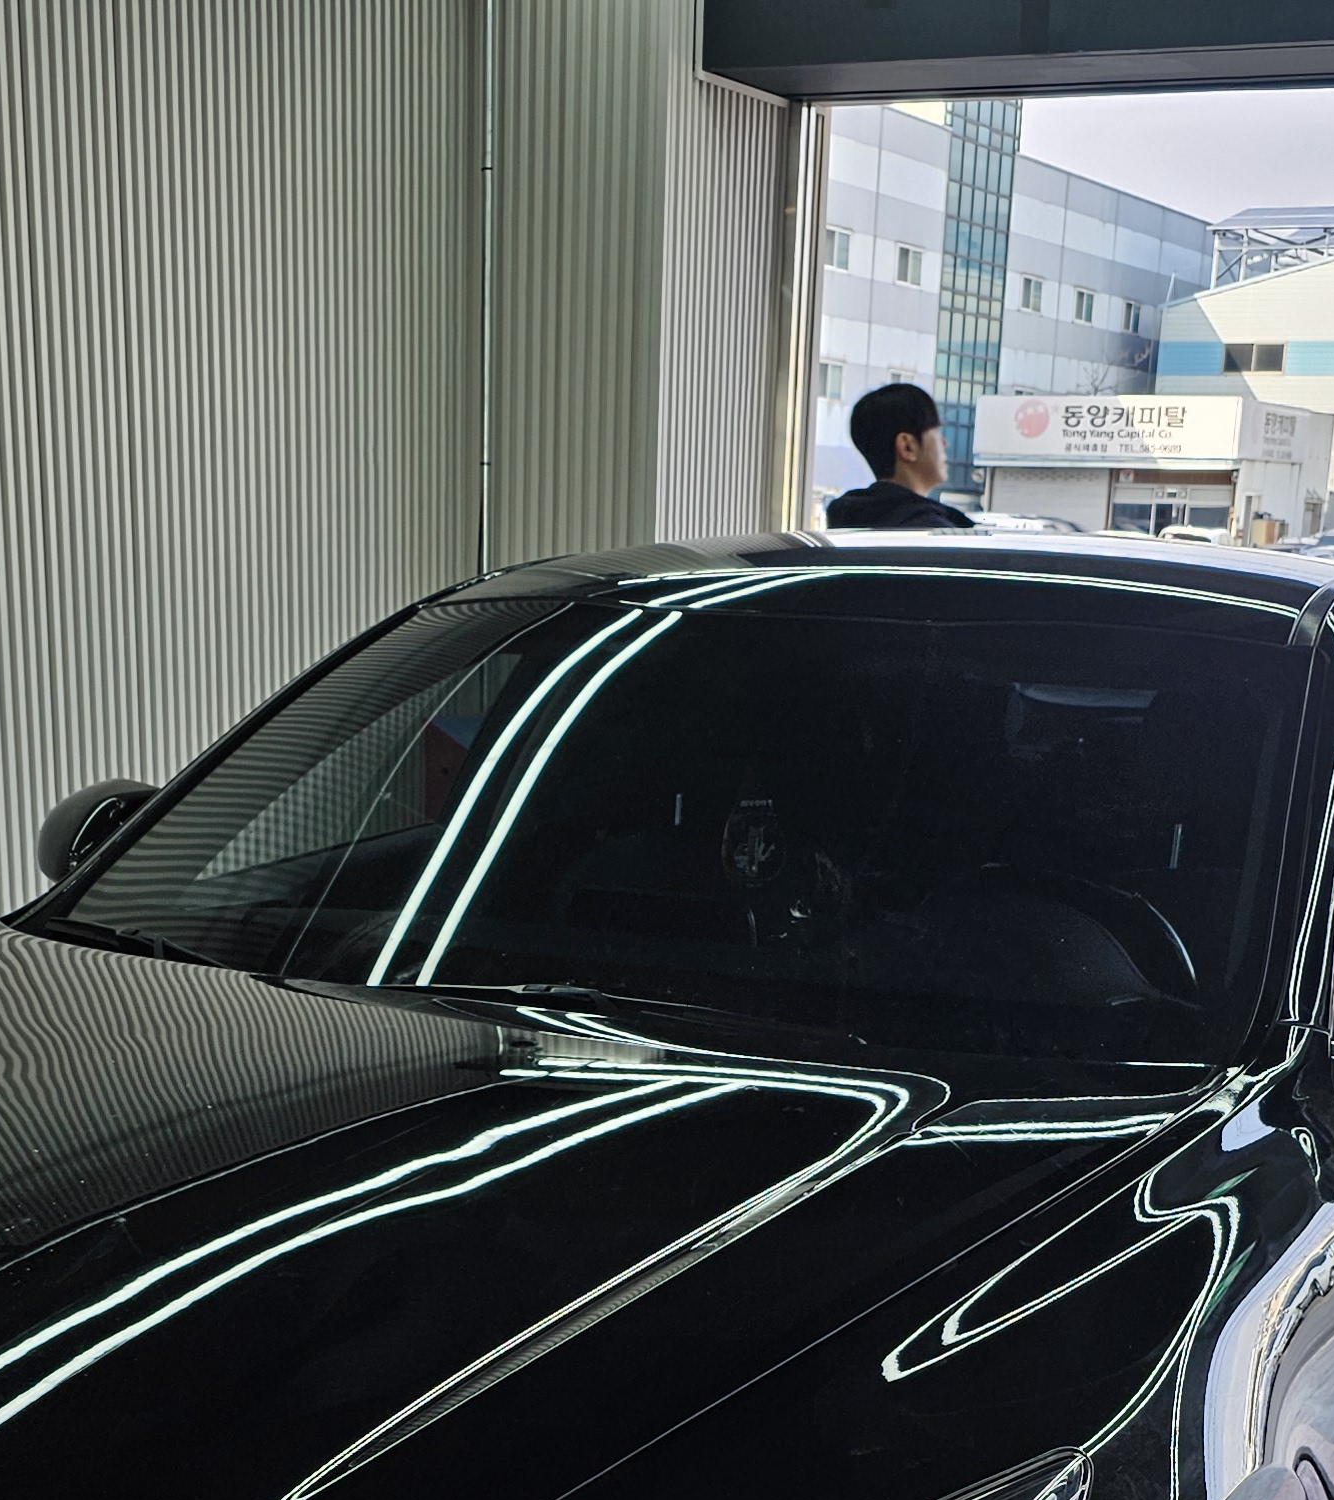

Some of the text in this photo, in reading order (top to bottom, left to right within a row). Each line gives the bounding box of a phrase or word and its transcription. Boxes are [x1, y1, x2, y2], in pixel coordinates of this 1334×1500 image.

[1061, 404, 1187, 428] 동양캐피탈
[1062, 428, 1086, 440] Tong
[1089, 428, 1114, 440] Yang
[1117, 428, 1155, 439] Capital
